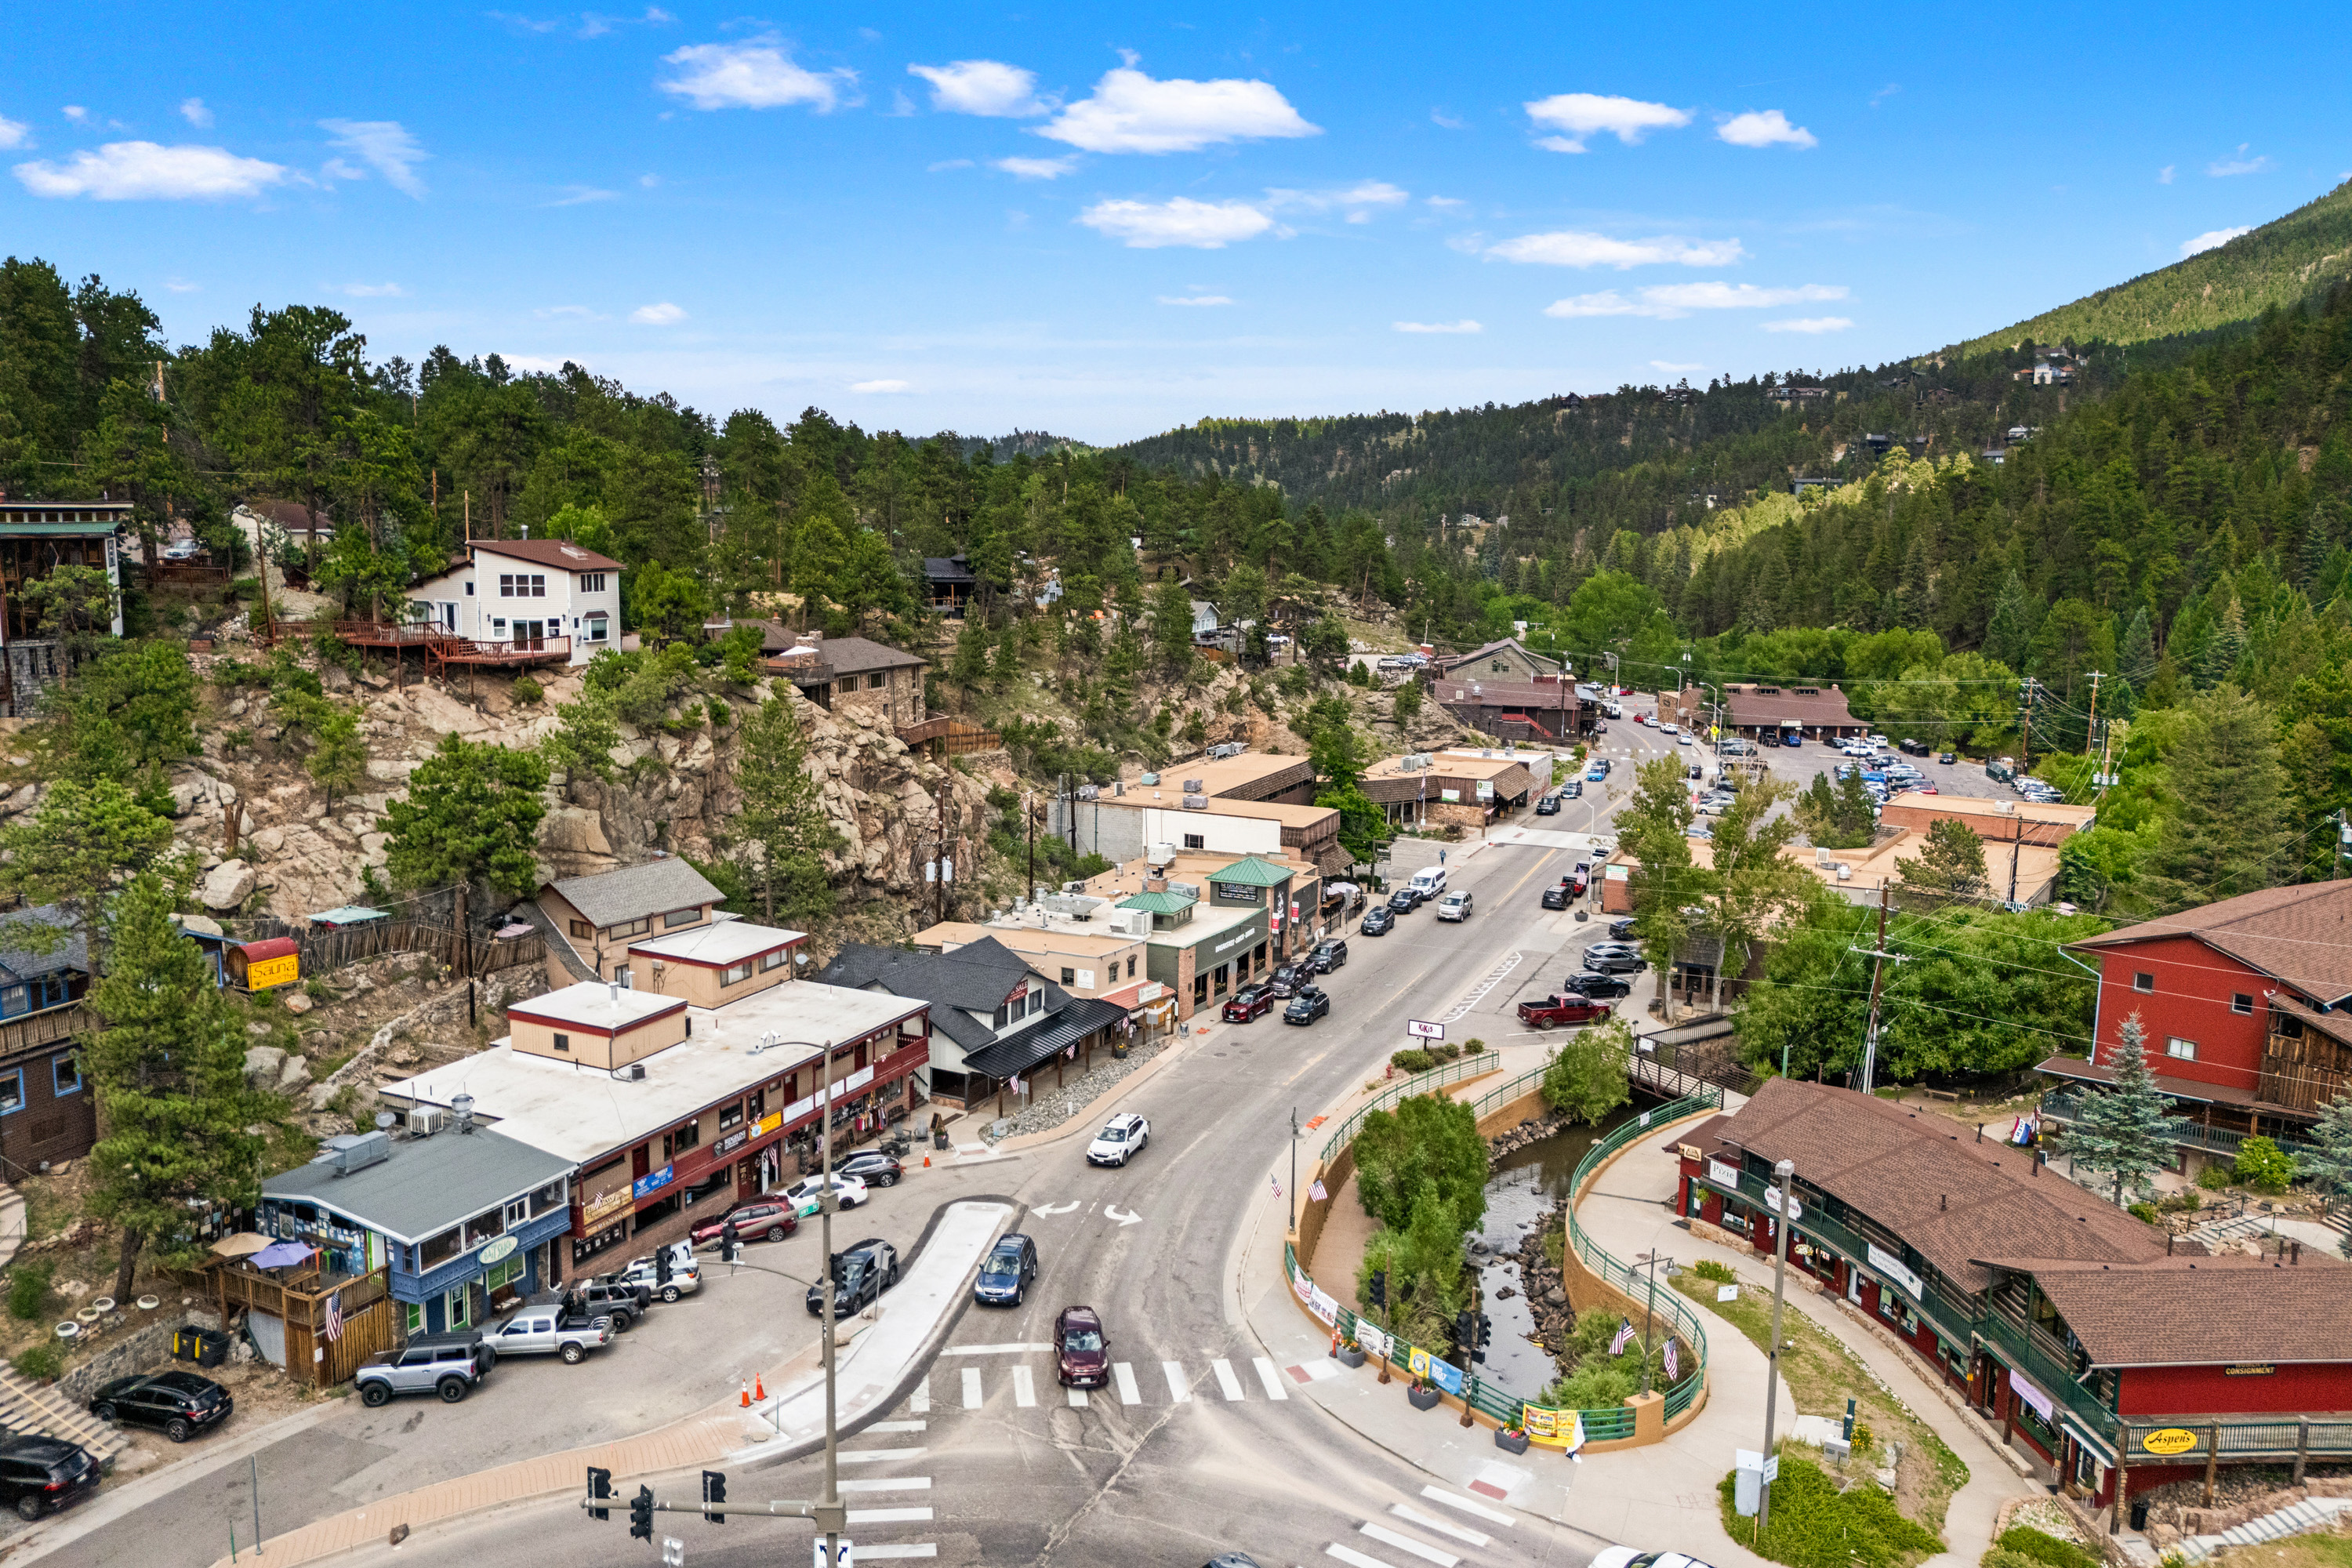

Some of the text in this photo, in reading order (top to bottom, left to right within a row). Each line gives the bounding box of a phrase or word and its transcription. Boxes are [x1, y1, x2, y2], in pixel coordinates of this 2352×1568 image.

[253, 961, 295, 978] Sauna
[724, 1130, 746, 1143] RIDGELINE
[1713, 1163, 1734, 1179] Pixie
[2225, 1367, 2275, 1375] CONSIGNMENT
